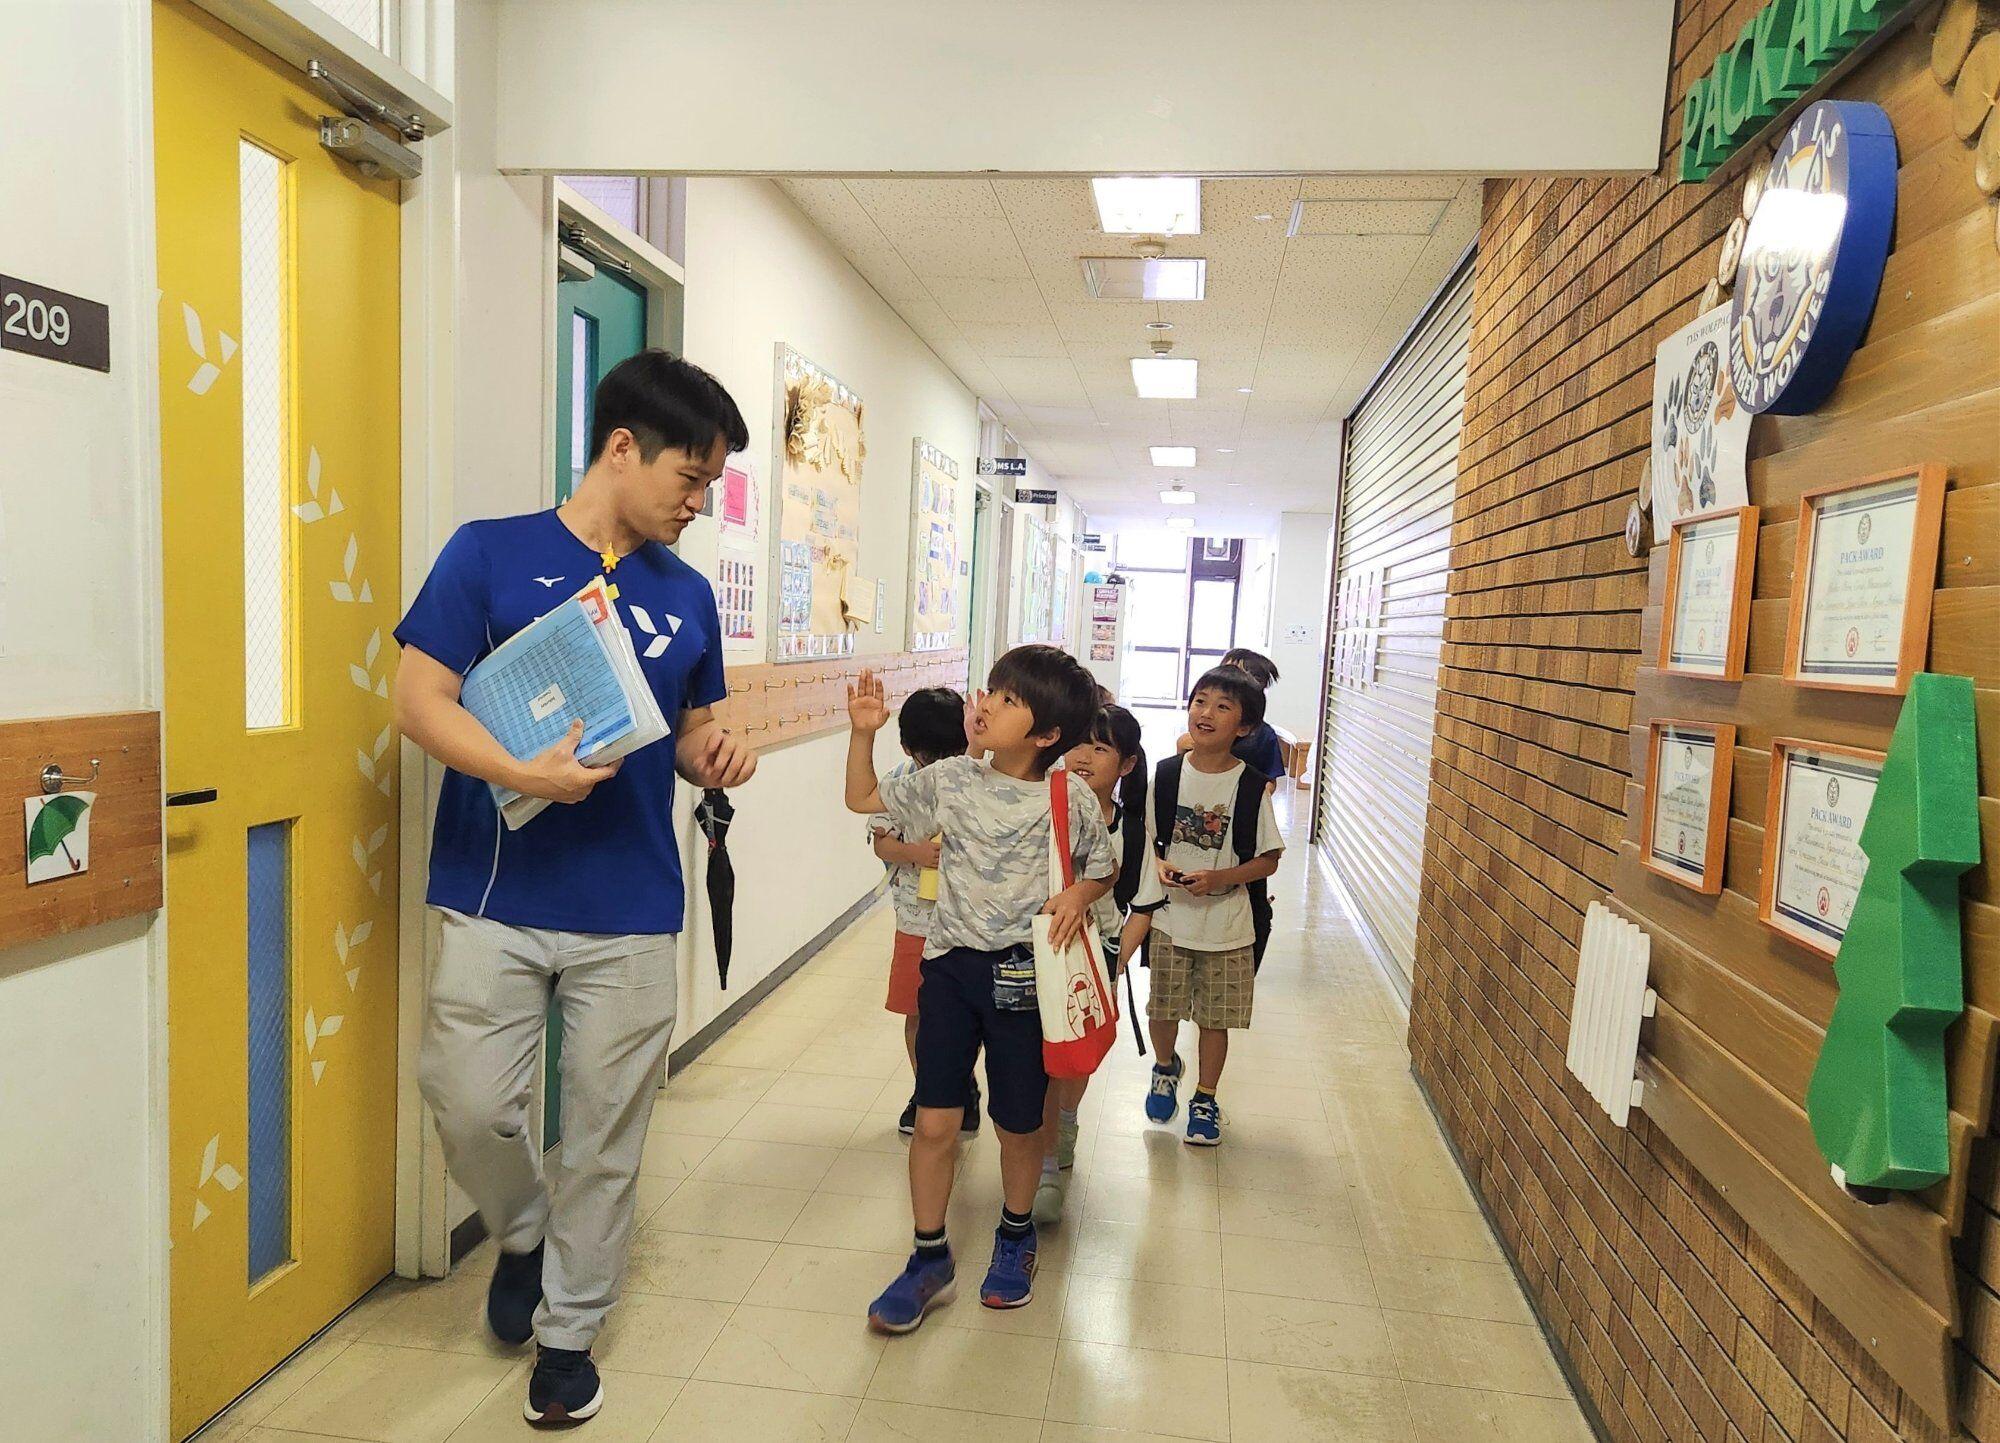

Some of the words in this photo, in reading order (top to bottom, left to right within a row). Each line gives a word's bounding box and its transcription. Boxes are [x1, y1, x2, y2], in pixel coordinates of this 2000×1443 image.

[4, 293, 71, 346] 209
[1763, 269, 1831, 403] WOLVES
[997, 462, 1010, 471] MS
[1010, 462, 1026, 471] L.A.
[1033, 492, 1057, 500] Principal
[1840, 551, 1857, 565] PACK
[1858, 546, 1884, 562] AWARD
[1810, 807, 1827, 823] PACK
[1827, 811, 1852, 829] AWARD
